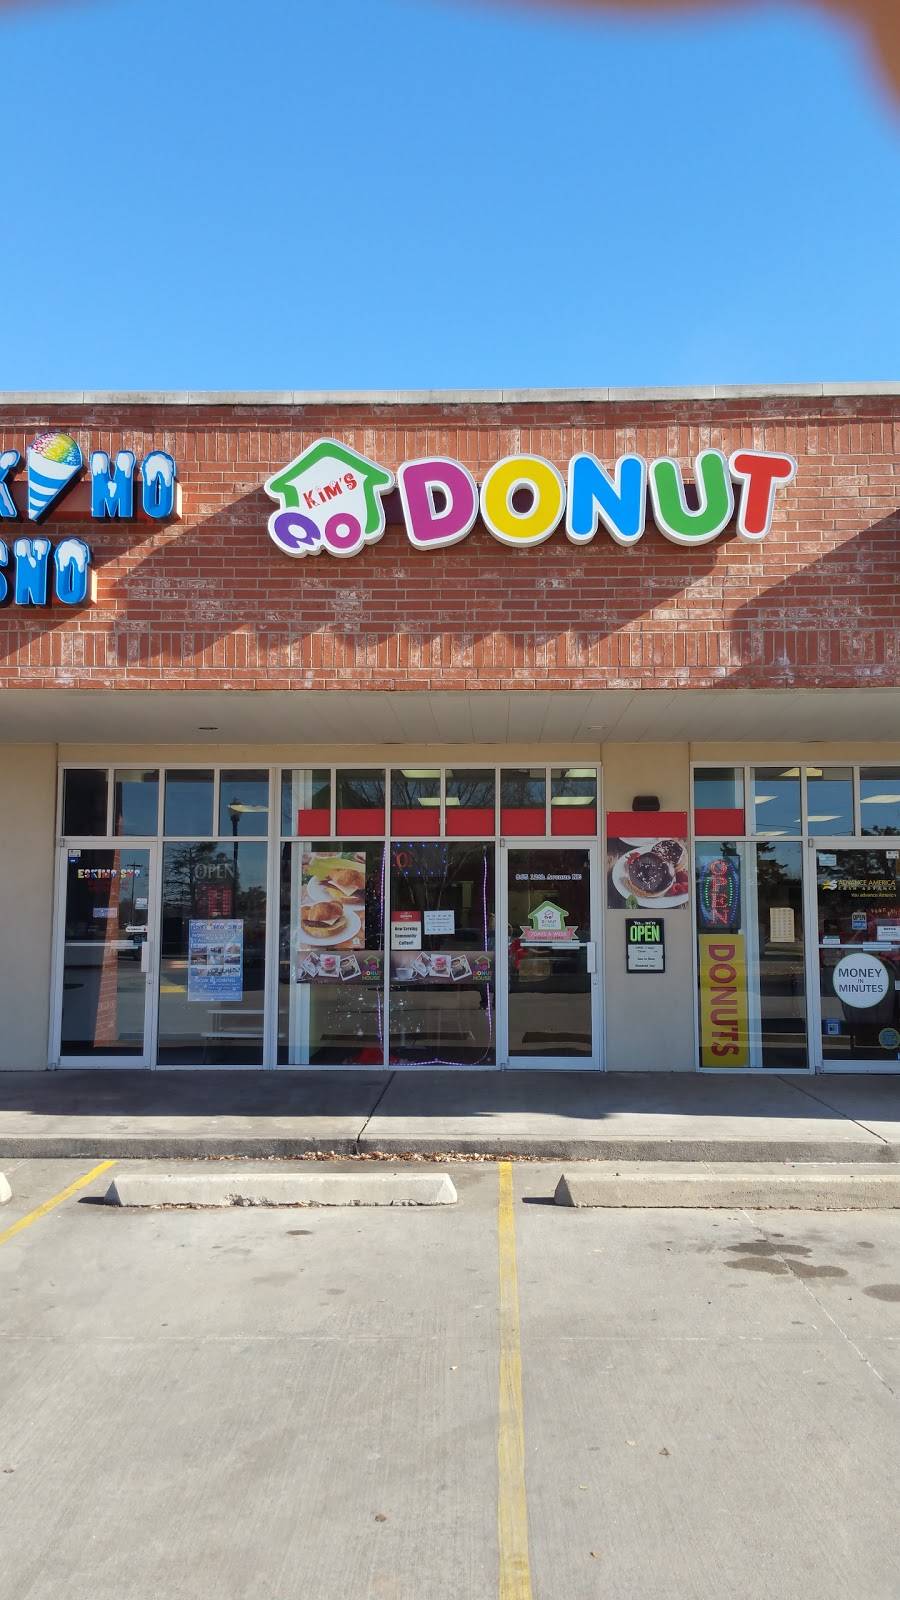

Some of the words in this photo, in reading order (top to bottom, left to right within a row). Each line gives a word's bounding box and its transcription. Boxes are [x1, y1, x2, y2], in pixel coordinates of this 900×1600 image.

[397, 448, 797, 550] DONUT
[630, 925, 660, 942] OPEN
[838, 968, 882, 978] MONEY
[839, 984, 884, 993] MINUTES
